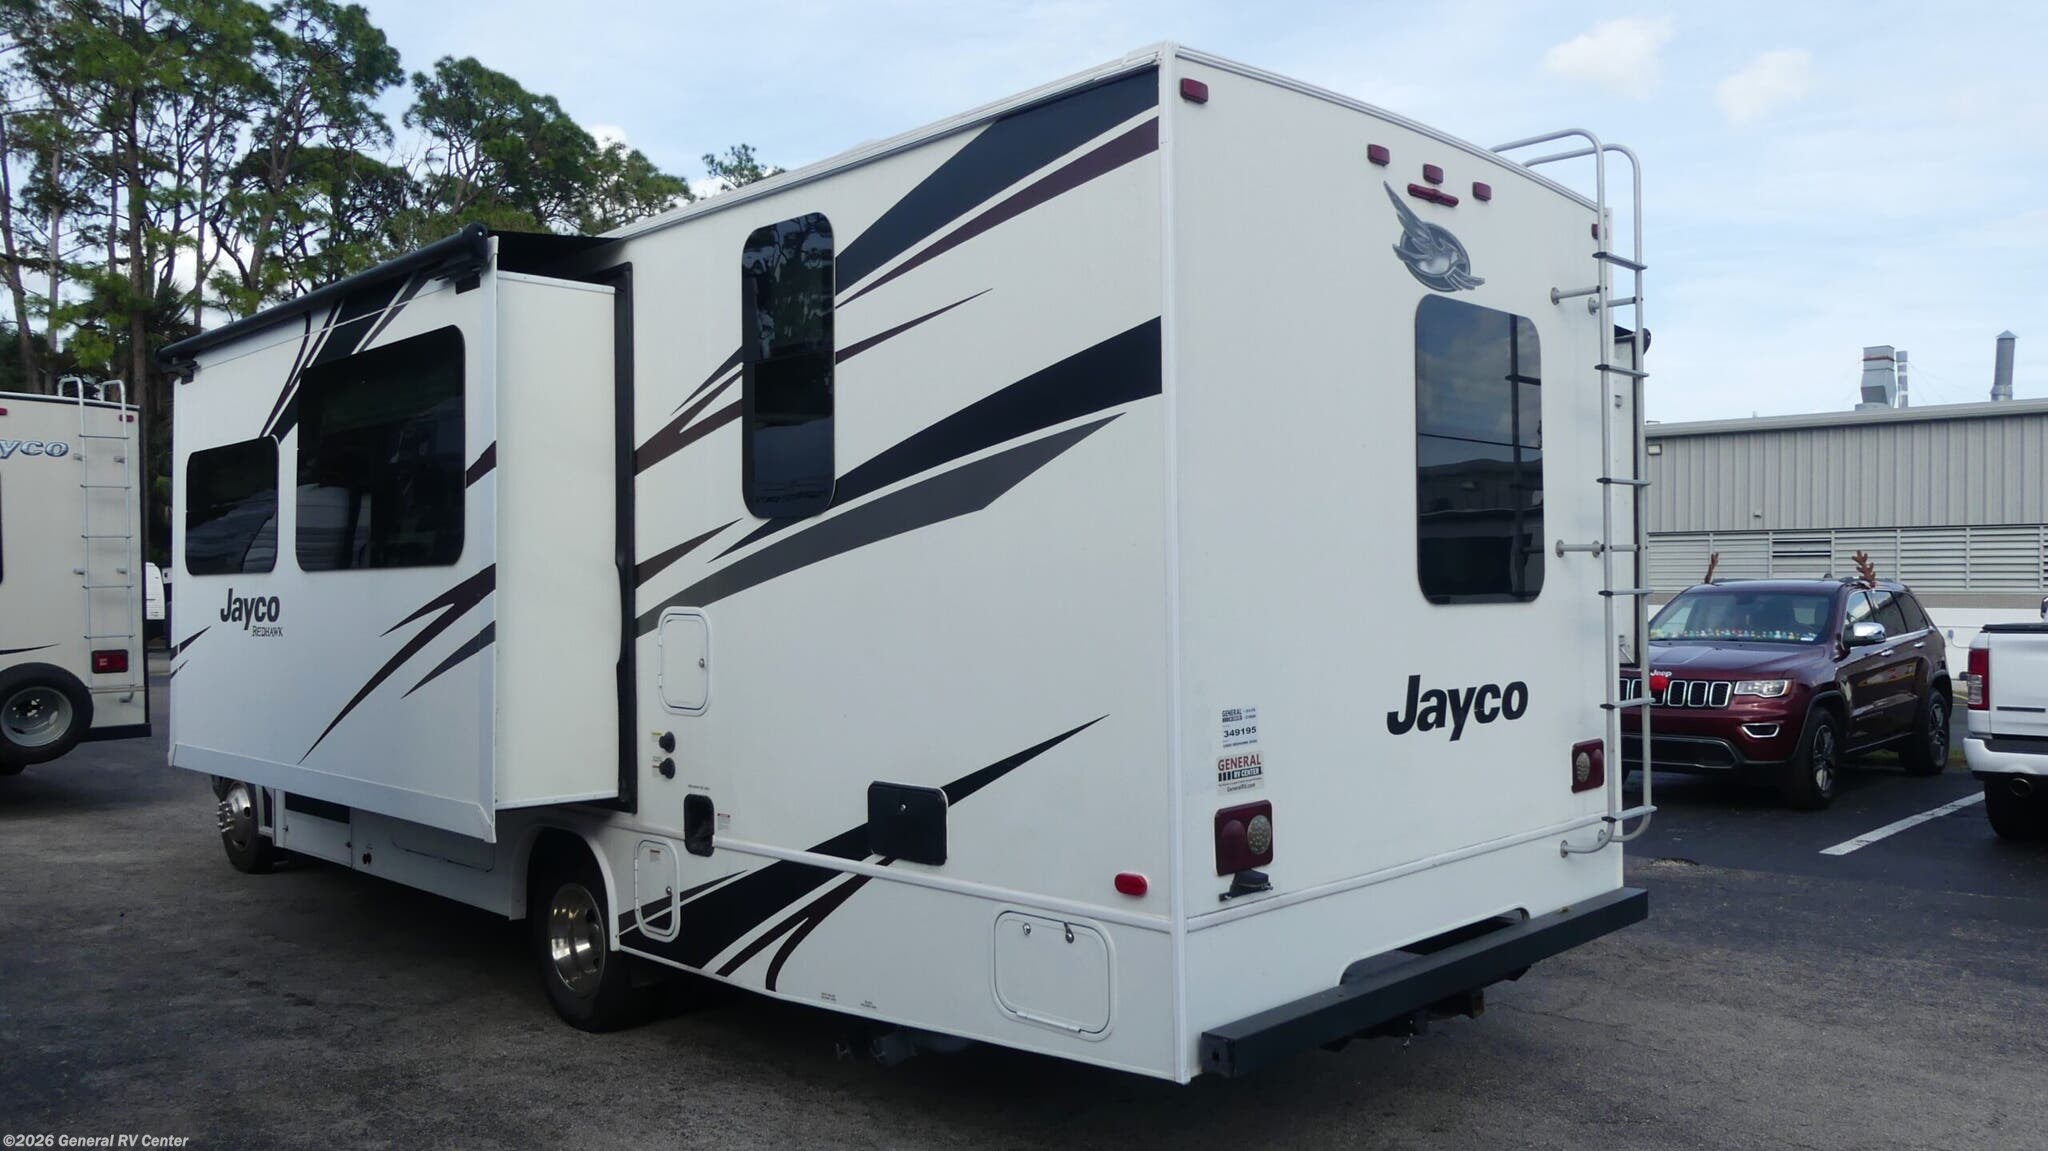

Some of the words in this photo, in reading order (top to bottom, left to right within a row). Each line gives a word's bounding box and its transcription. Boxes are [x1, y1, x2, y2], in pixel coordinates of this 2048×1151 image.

[220, 588, 280, 631] Jayco
[252, 626, 283, 638] REDHAWK
[1650, 669, 1673, 678] Jeep
[1386, 674, 1529, 742] Jayco
[1223, 726, 1257, 738] 349195
[1217, 754, 1262, 771] GENERAL
[1241, 767, 1260, 777] CENTER
